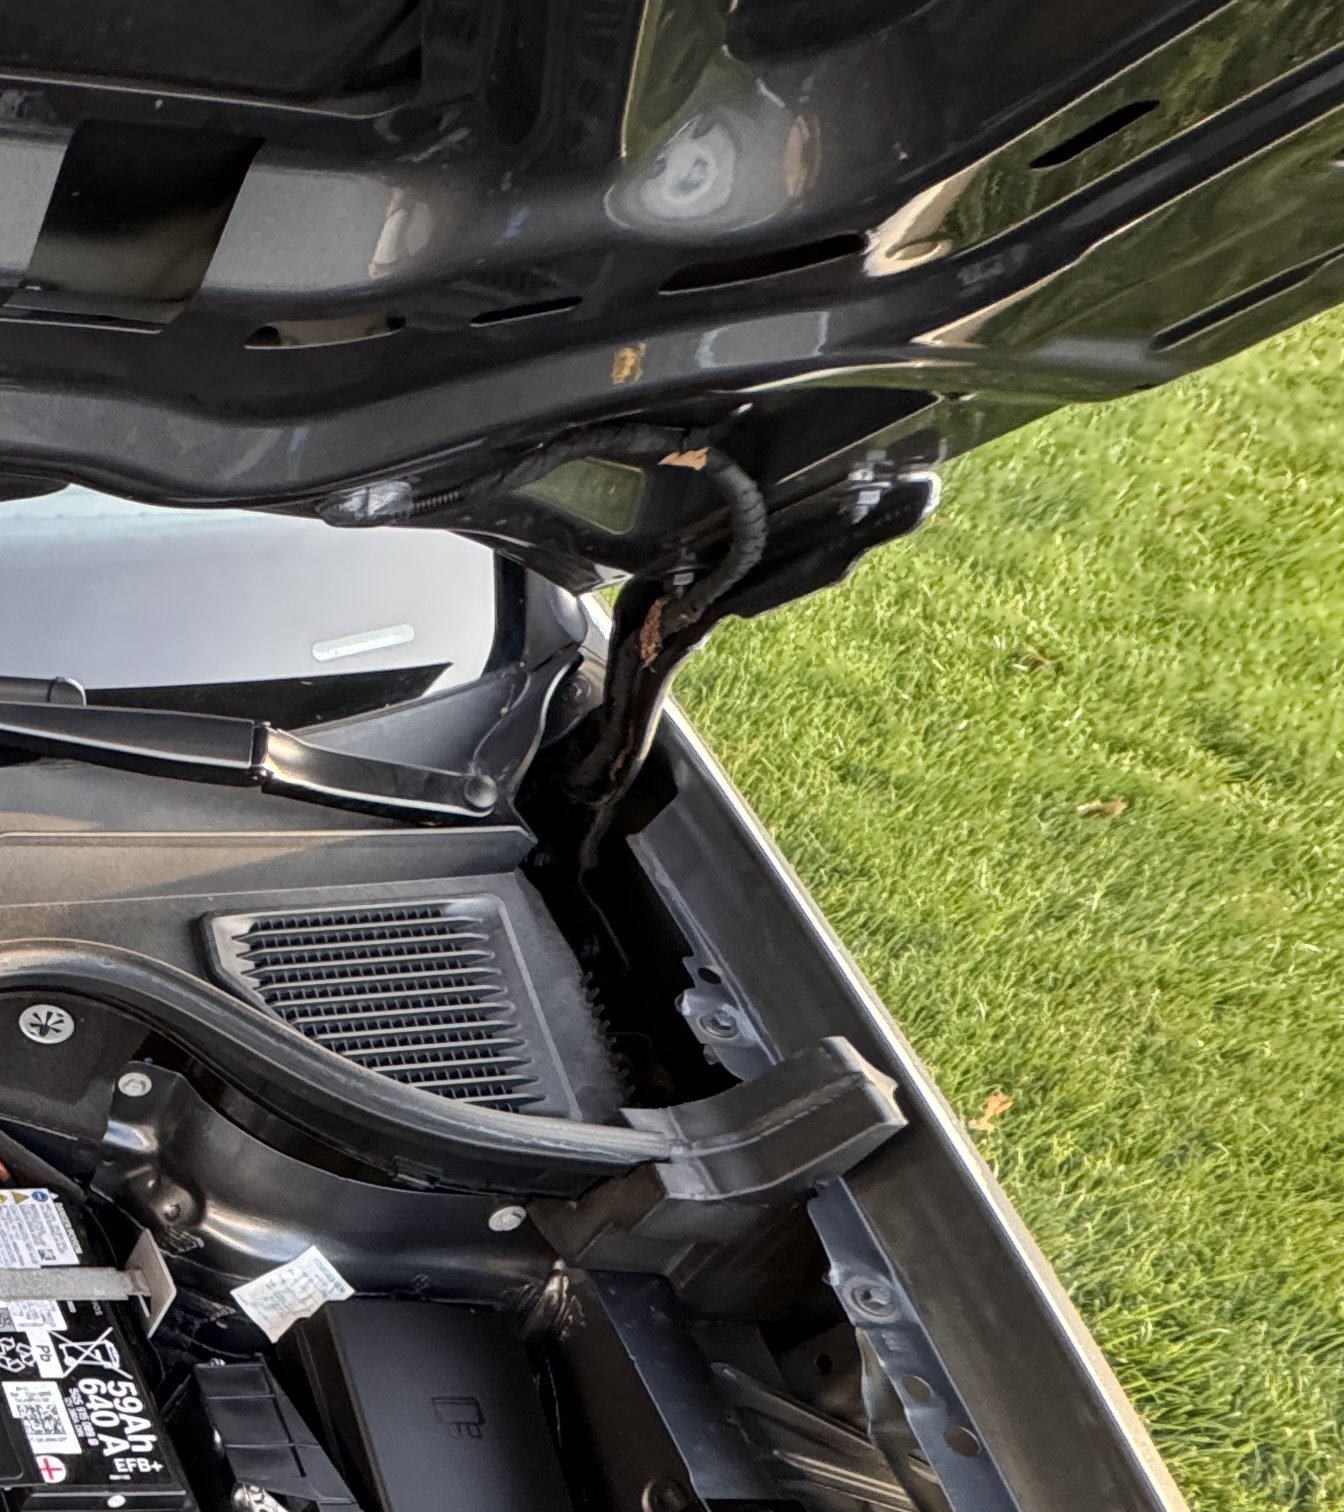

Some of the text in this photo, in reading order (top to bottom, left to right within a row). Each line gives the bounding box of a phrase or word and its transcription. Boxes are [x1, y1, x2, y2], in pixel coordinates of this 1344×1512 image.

[35, 1344, 52, 1363] Pb
[77, 1377, 121, 1428] 640
[106, 1380, 158, 1454] 59Ah
[96, 1432, 131, 1457] A
[113, 1457, 164, 1473] EFB+
